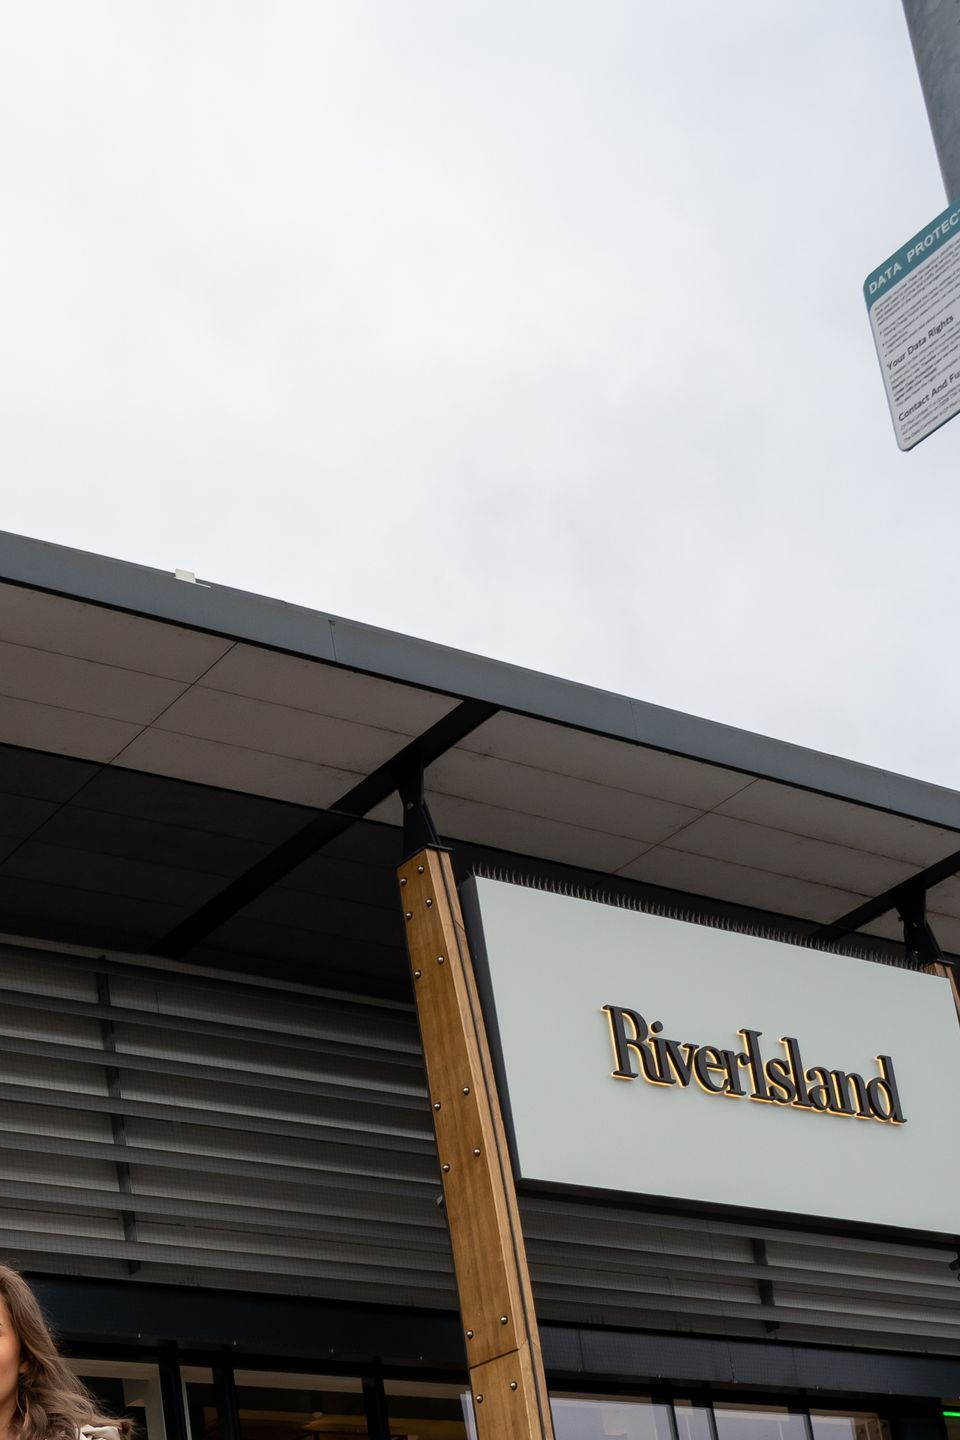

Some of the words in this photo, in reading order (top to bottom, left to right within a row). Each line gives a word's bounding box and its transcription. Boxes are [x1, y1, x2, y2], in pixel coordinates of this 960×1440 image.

[869, 262, 902, 295] DATA
[887, 353, 906, 371] Your
[907, 336, 927, 355] Data
[928, 315, 954, 338] Rights
[898, 394, 930, 421] Contact
[931, 379, 948, 398] And
